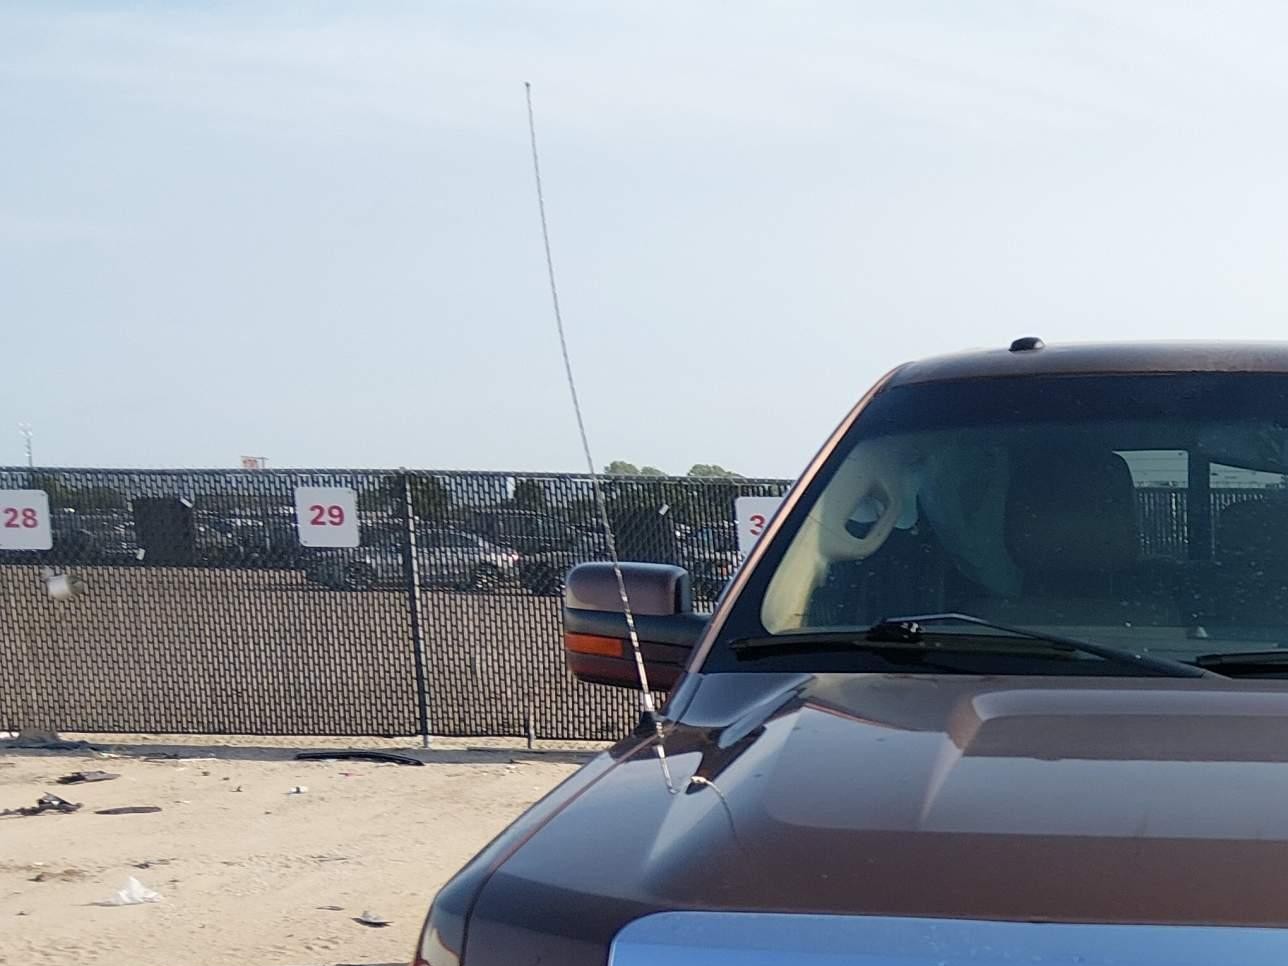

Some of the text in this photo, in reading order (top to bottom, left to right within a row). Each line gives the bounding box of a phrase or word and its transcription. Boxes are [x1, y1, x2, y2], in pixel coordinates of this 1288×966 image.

[3, 507, 38, 529] 28
[309, 504, 345, 526] 29
[750, 514, 766, 536] 3
